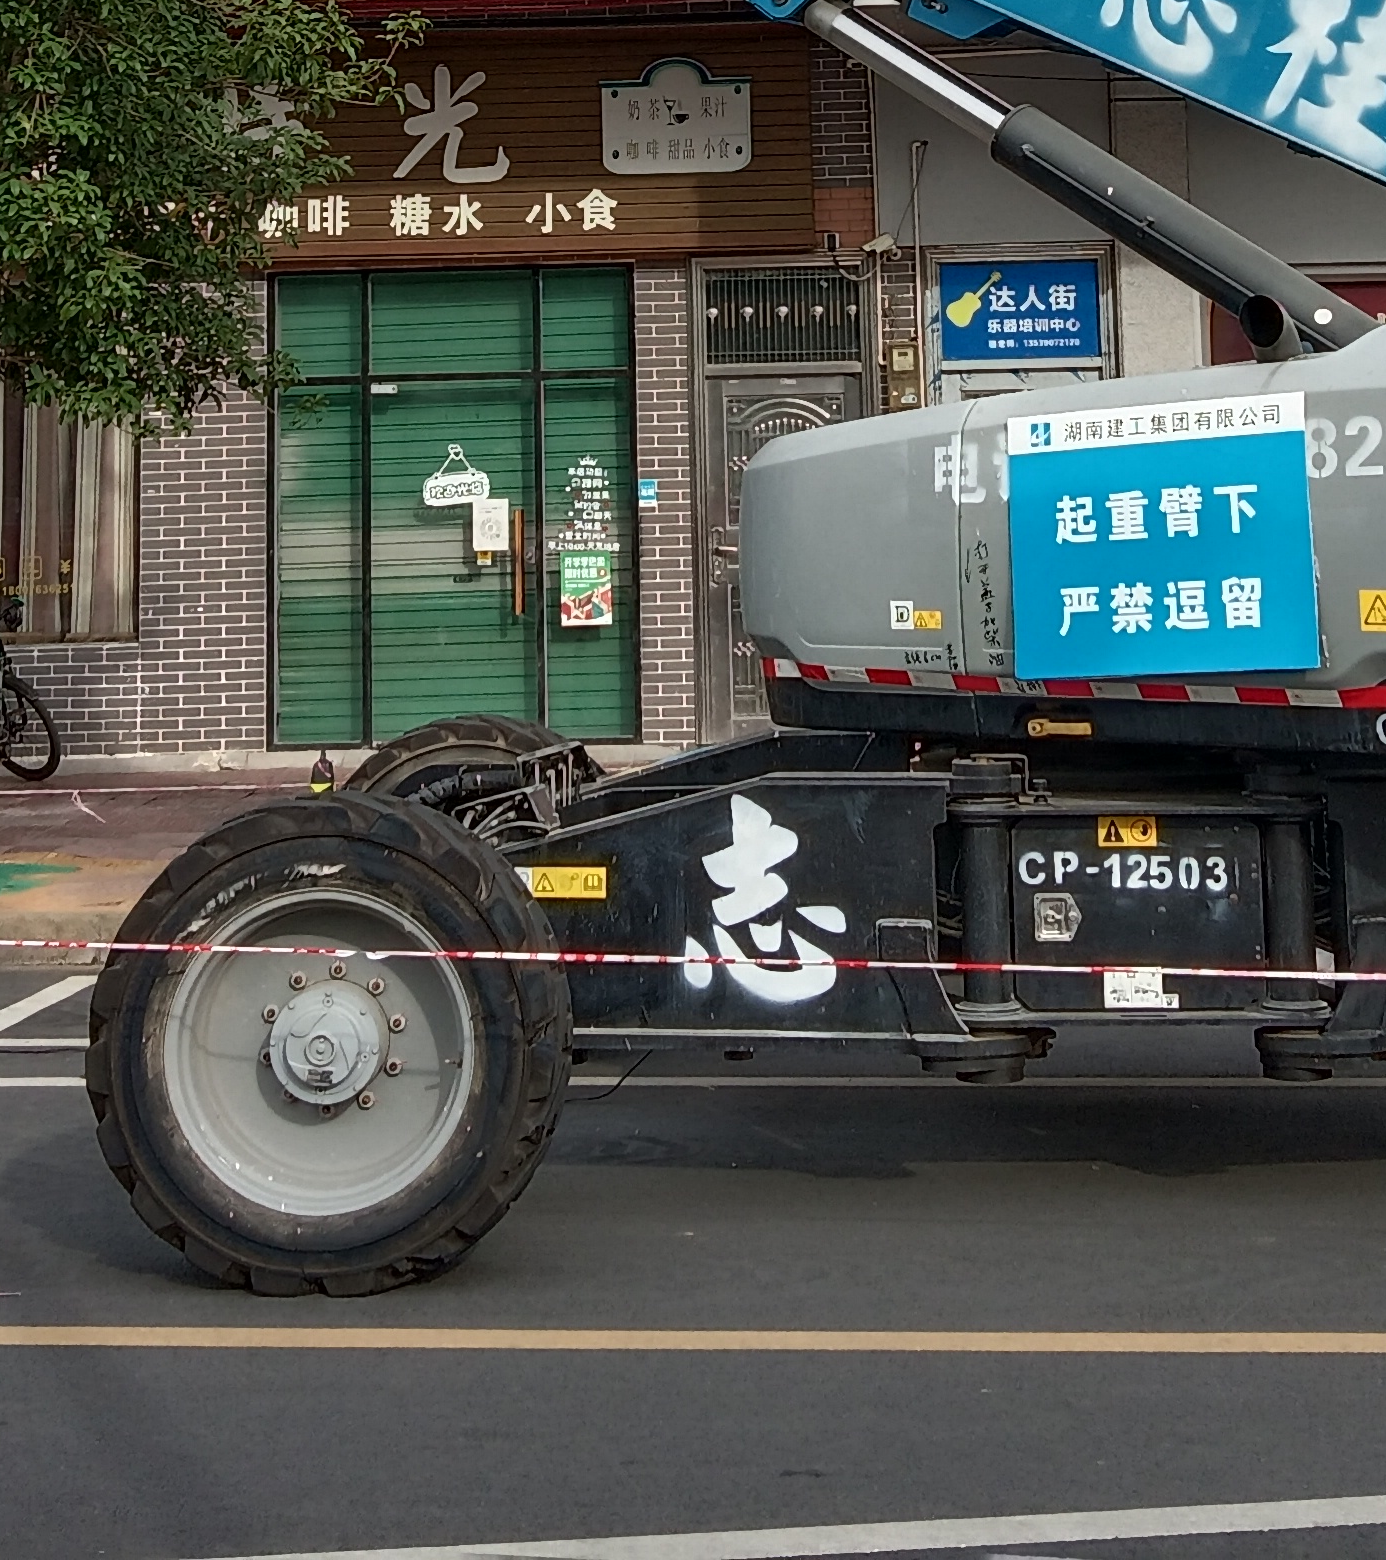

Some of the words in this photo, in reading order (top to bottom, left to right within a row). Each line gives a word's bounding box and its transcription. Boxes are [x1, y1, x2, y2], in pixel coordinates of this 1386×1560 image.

[627, 97, 660, 121] 奶茶
[700, 95, 727, 118] 果汁
[626, 138, 659, 160] 咖啡
[668, 138, 695, 160] 甜品
[703, 137, 730, 160] 小食
[389, 193, 484, 236] 糖水
[525, 188, 618, 234] 小食
[988, 284, 1077, 312] 达人街
[987, 317, 1081, 333] 乐器培训中心
[1062, 402, 1283, 444] 湖南建工集团有限公司
[1054, 483, 1261, 546] 起重臂下
[1058, 576, 1263, 637] 严禁逗留
[1018, 850, 1230, 892] CP-12503
[683, 793, 848, 1004] 志
